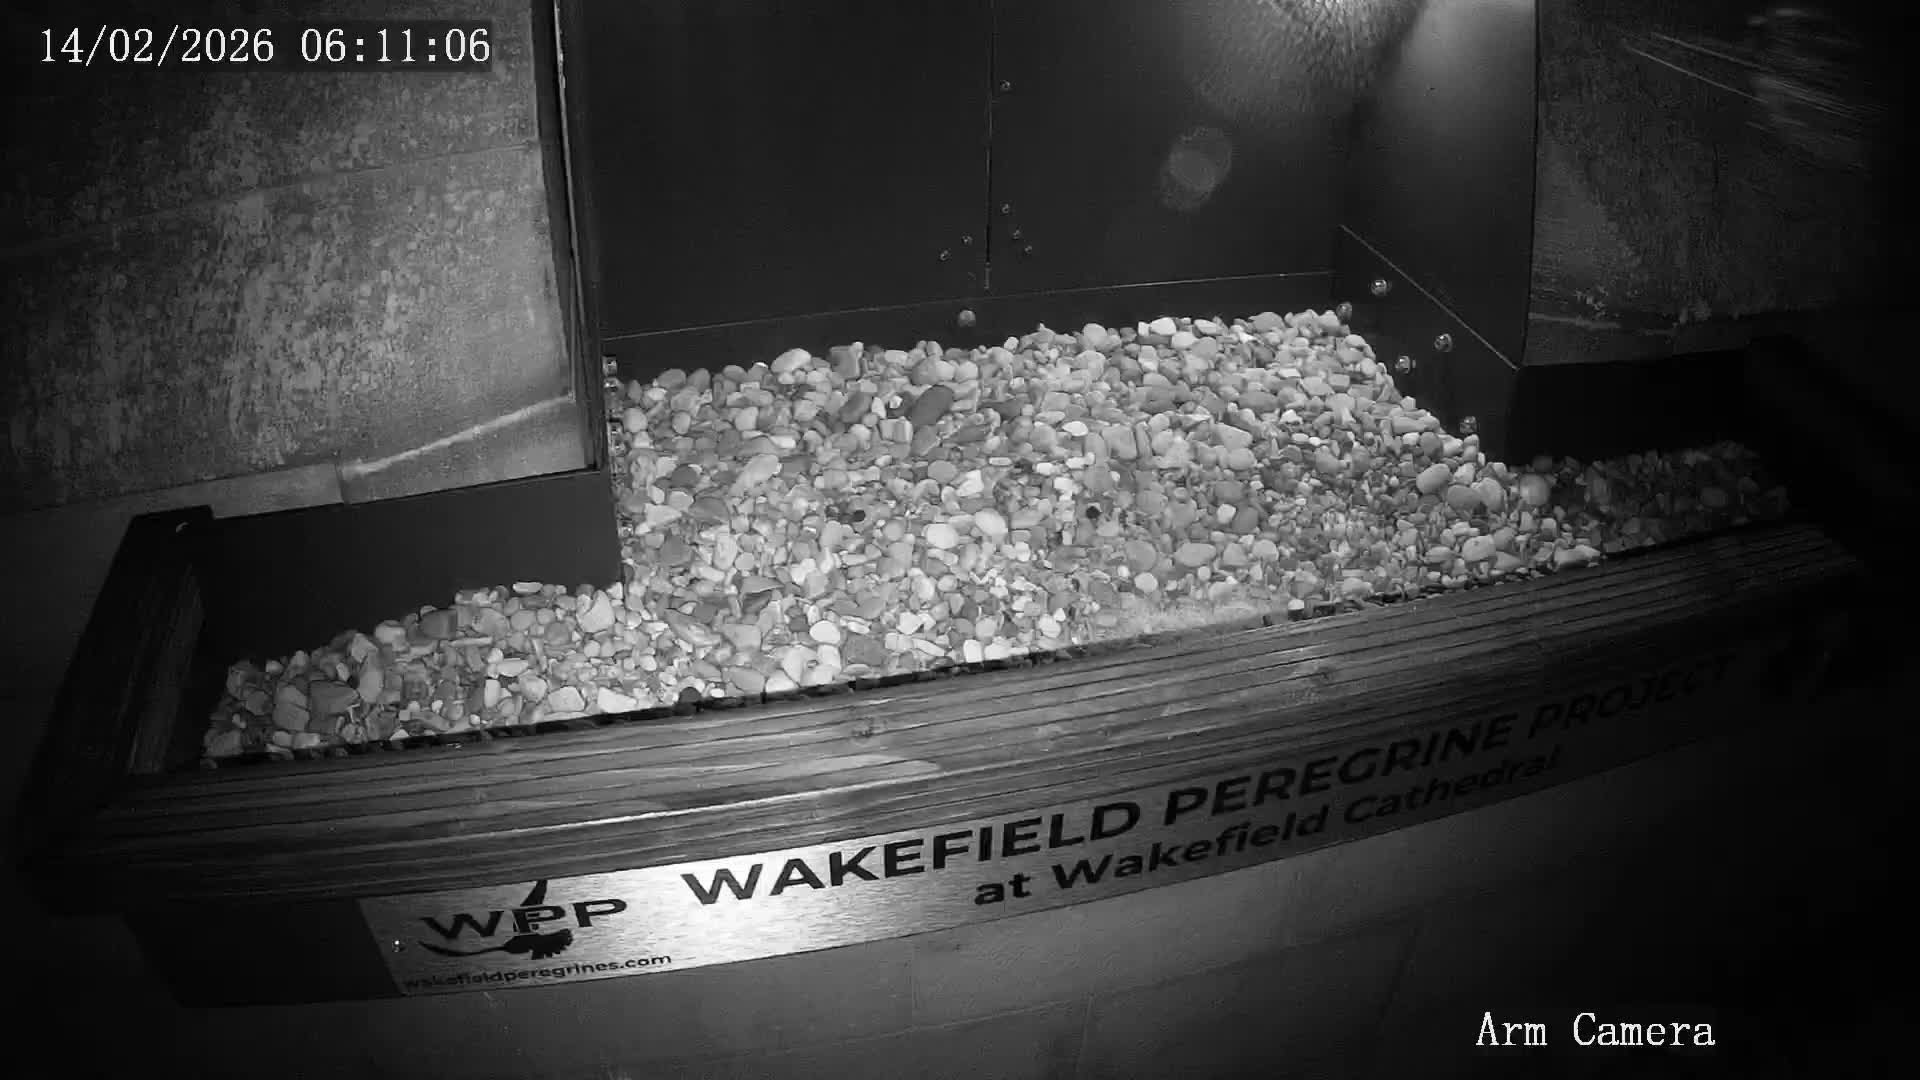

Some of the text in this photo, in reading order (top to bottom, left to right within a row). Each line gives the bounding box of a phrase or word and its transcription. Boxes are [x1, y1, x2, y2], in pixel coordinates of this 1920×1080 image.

[681, 657, 1731, 906] WAKEFIELD PEREGRINE PROJECT
[973, 745, 1561, 905] at Wakefield Cathedral
[420, 898, 627, 940] WPP
[404, 954, 672, 990] wakefieldperegrines.com
